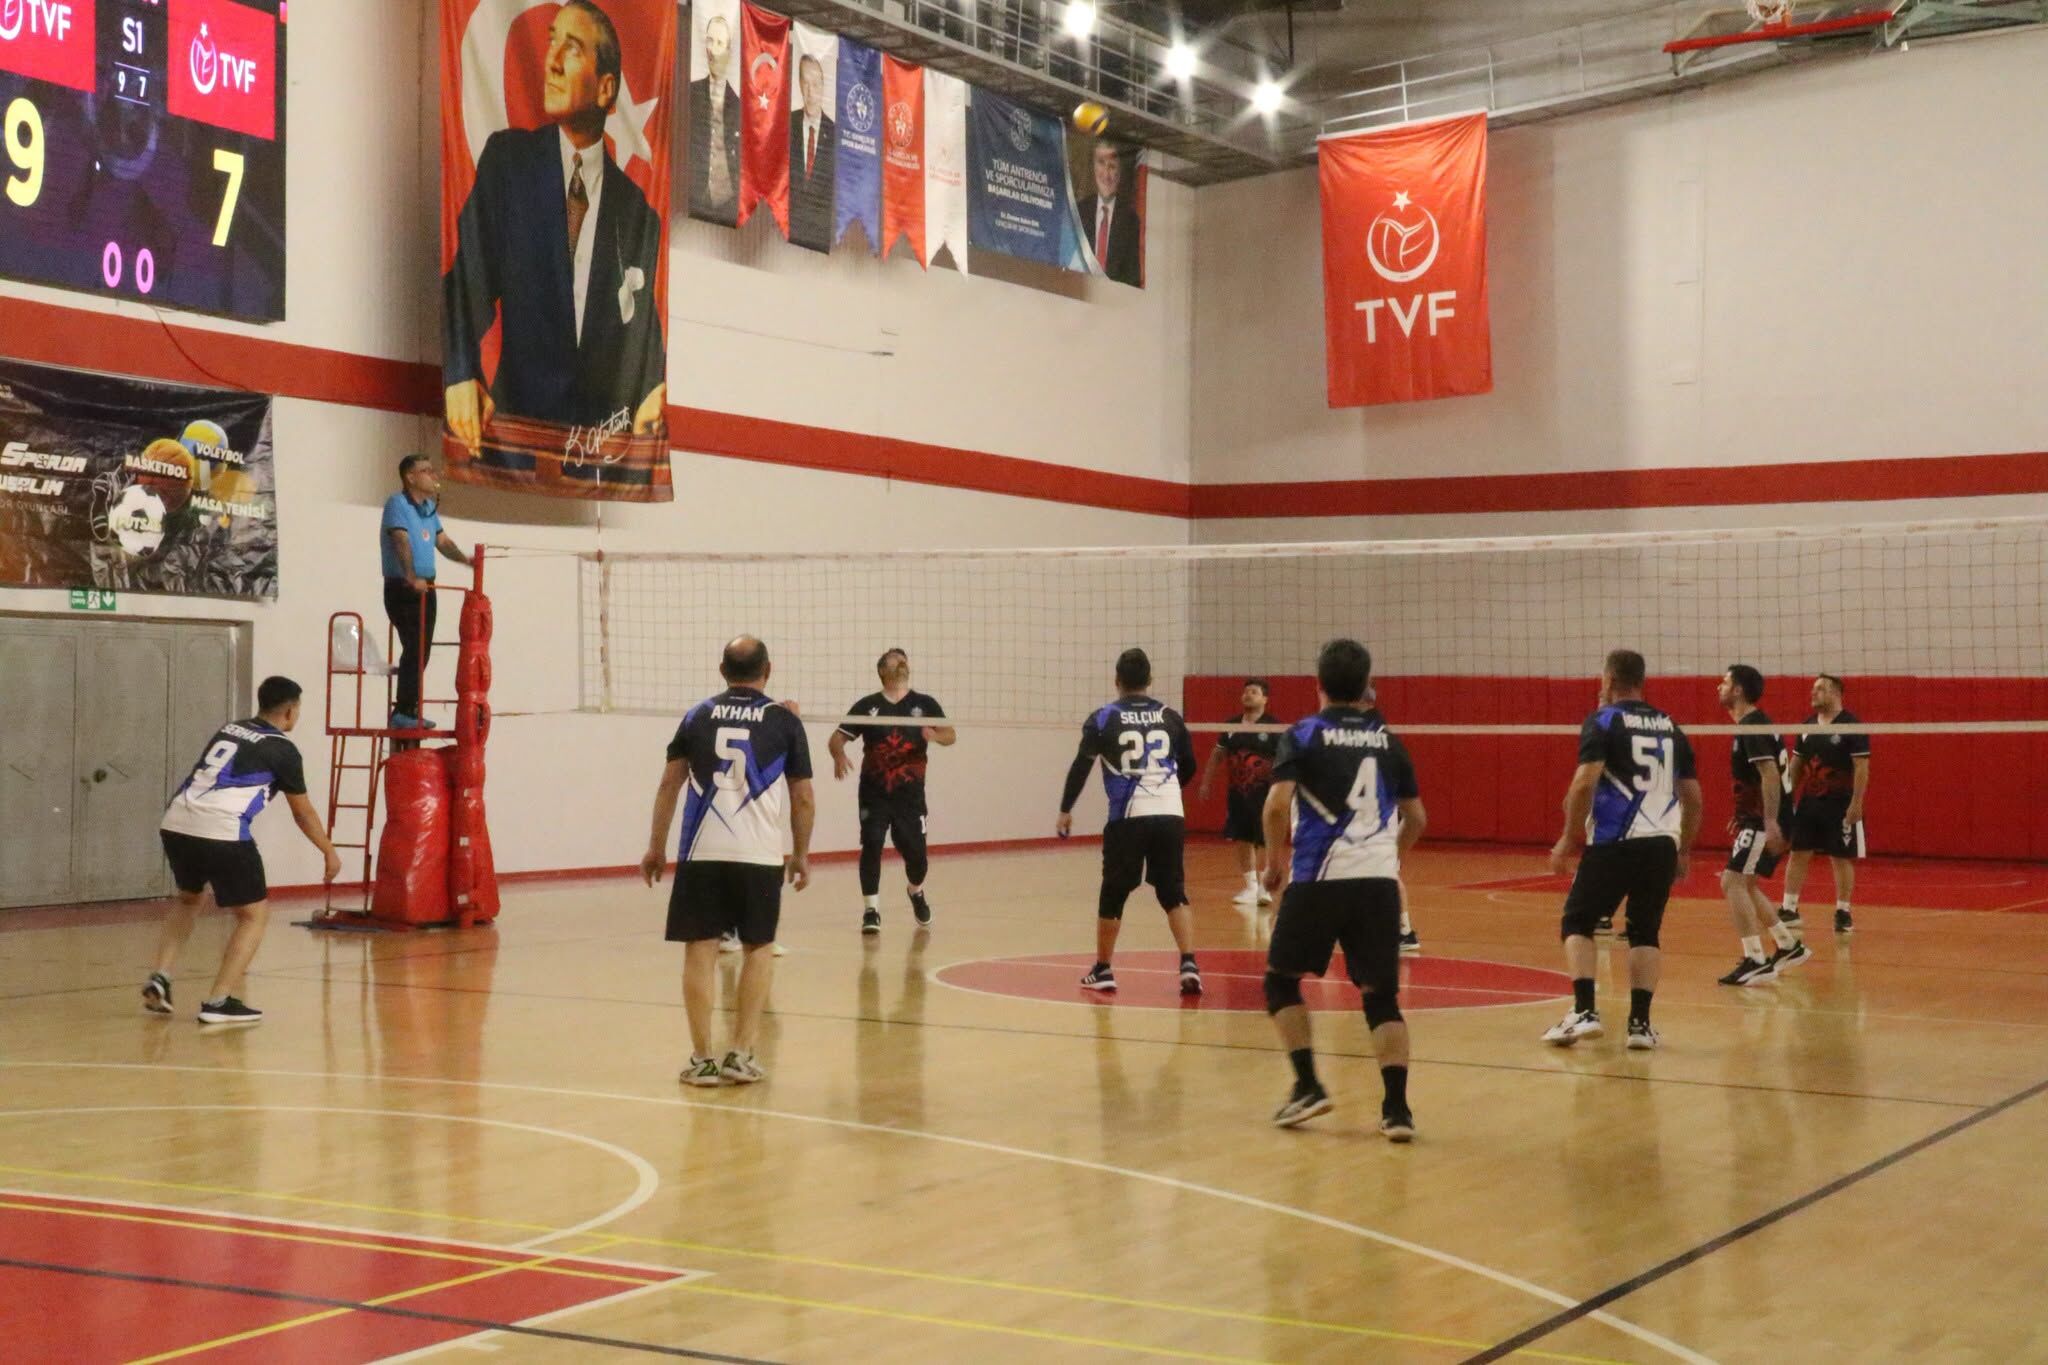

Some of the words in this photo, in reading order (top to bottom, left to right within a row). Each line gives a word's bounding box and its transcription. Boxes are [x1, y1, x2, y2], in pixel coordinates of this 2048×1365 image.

[27, 0, 72, 41] TVF
[118, 72, 126, 92] 9
[138, 76, 147, 98] 7
[219, 53, 256, 93] TVF
[4, 97, 45, 207] 9
[212, 149, 244, 247] 7
[103, 241, 122, 287] 0
[136, 248, 154, 293] 0
[1355, 290, 1457, 344] TVF
[125, 455, 188, 479] BASKETBOL
[196, 442, 245, 465] VOLEYBOL
[191, 495, 223, 514] MASA
[710, 703, 765, 723] AYHAN
[1120, 711, 1164, 727] SELÇUK
[194, 740, 238, 787] 9
[712, 727, 750, 791] 5
[1118, 729, 1171, 776] 22
[1632, 735, 1674, 793] 51
[1346, 756, 1381, 827] 4
